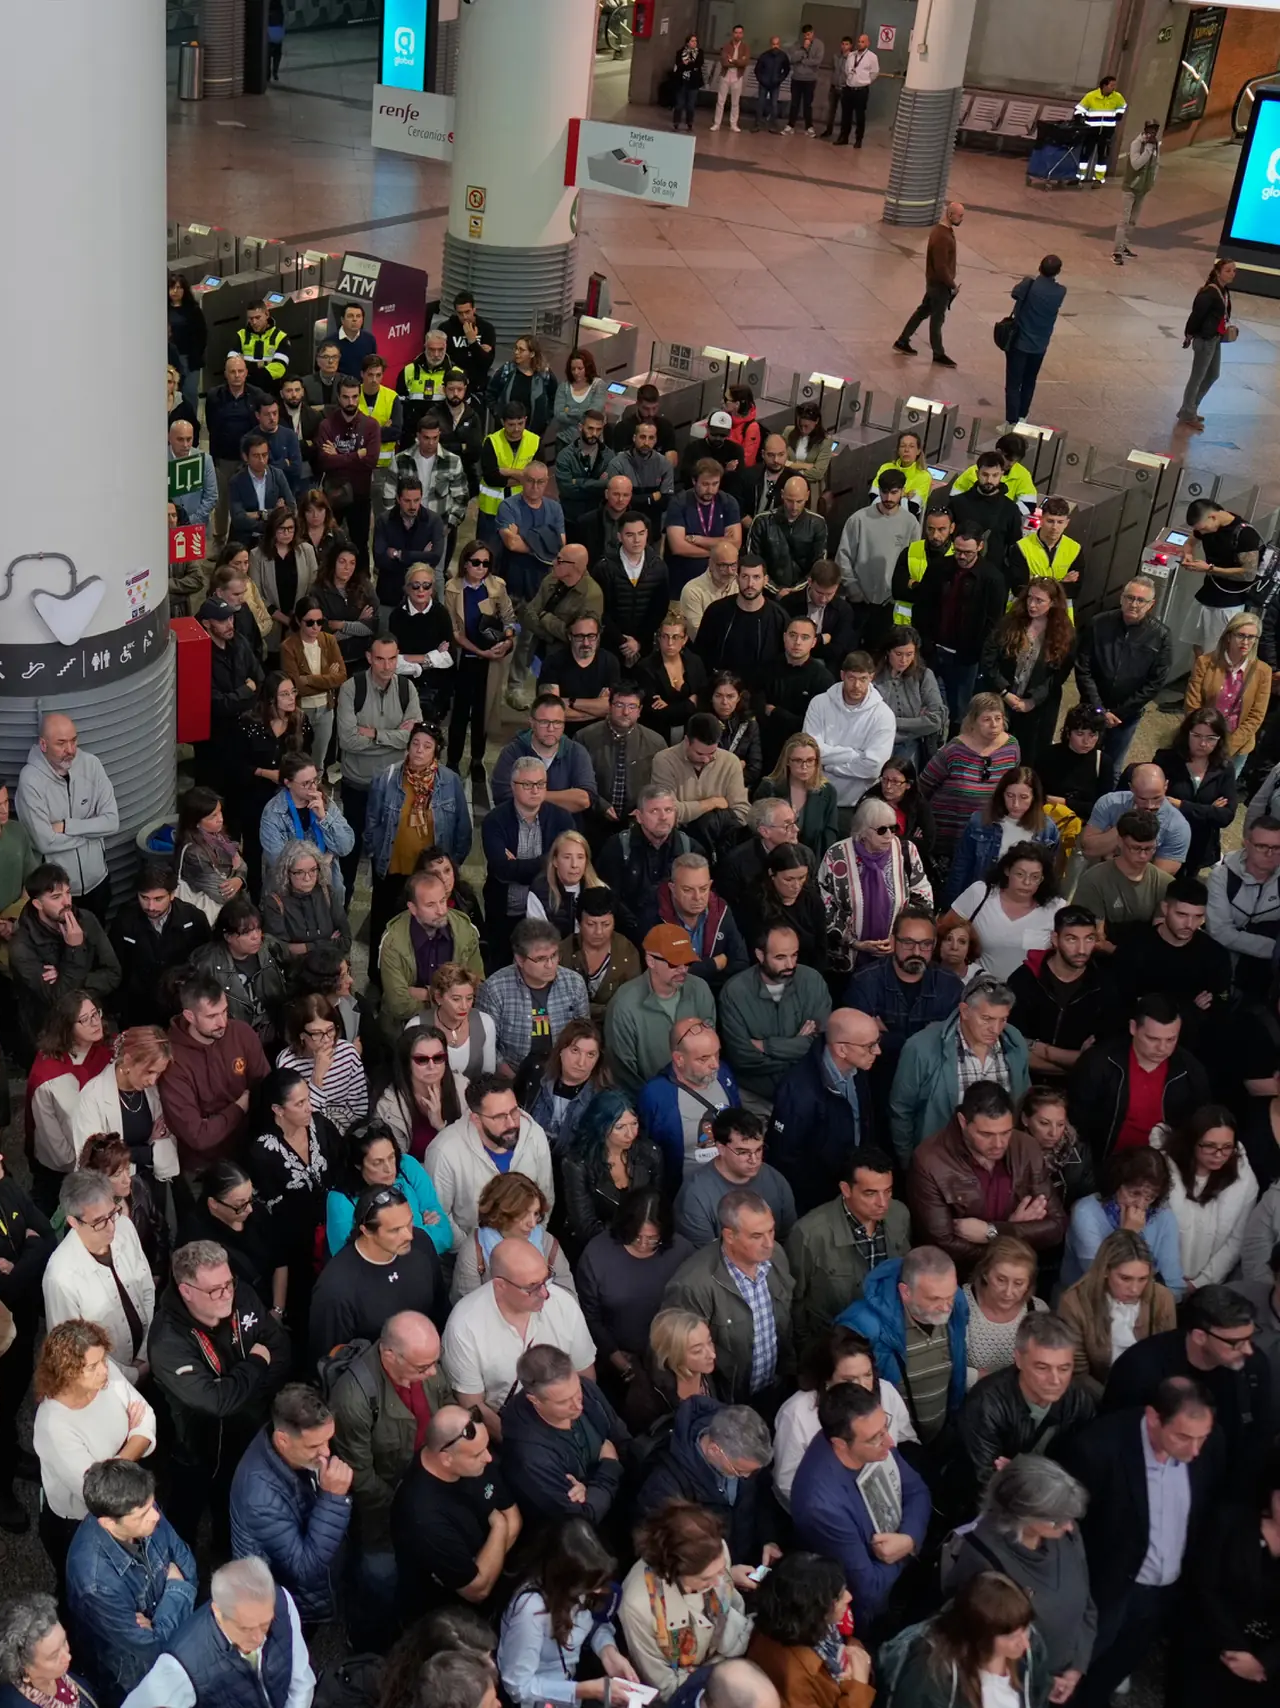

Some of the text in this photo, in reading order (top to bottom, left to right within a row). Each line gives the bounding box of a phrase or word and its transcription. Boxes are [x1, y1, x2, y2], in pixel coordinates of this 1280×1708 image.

[394, 56, 414, 66] global
[379, 103, 420, 124] renfe
[407, 125, 447, 142] Cercanías
[630, 131, 654, 142] Tarjetas
[628, 140, 645, 149] Cards
[652, 178, 678, 189] Solo QR
[662, 187, 675, 198] only
[337, 273, 377, 298] ATM
[387, 322, 411, 339] ATM
[452, 335, 482, 348] VAS
[126, 640, 136, 649] WC
